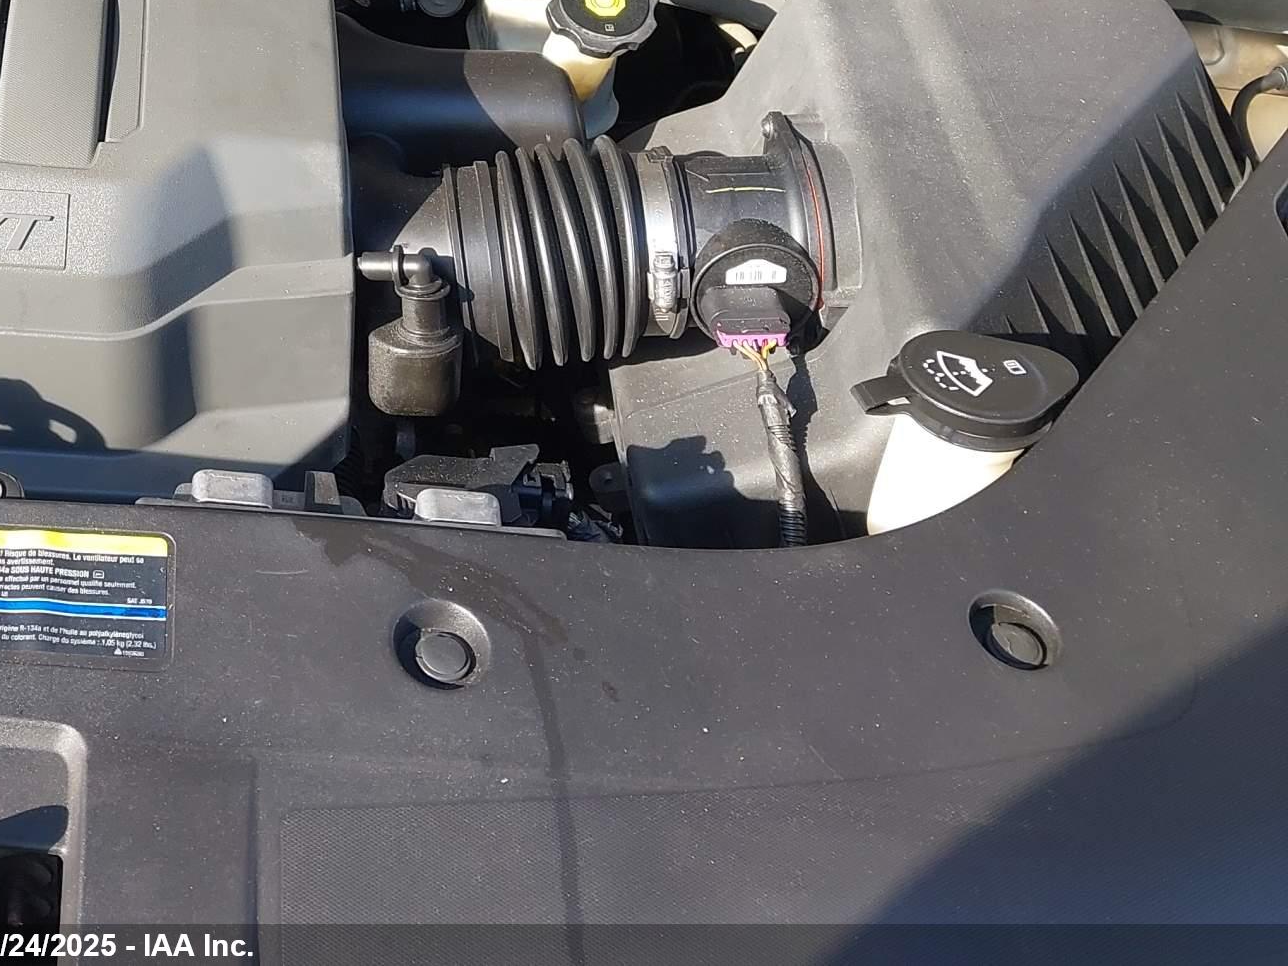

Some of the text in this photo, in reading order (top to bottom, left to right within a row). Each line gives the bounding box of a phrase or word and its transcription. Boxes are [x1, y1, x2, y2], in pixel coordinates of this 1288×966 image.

[5, 549, 27, 558] Risque
[119, 555, 135, 564] peut
[11, 565, 30, 574] SOUS
[31, 566, 54, 574] HAUTE
[55, 568, 90, 577] PRESSION
[38, 635, 60, 643] Charge
